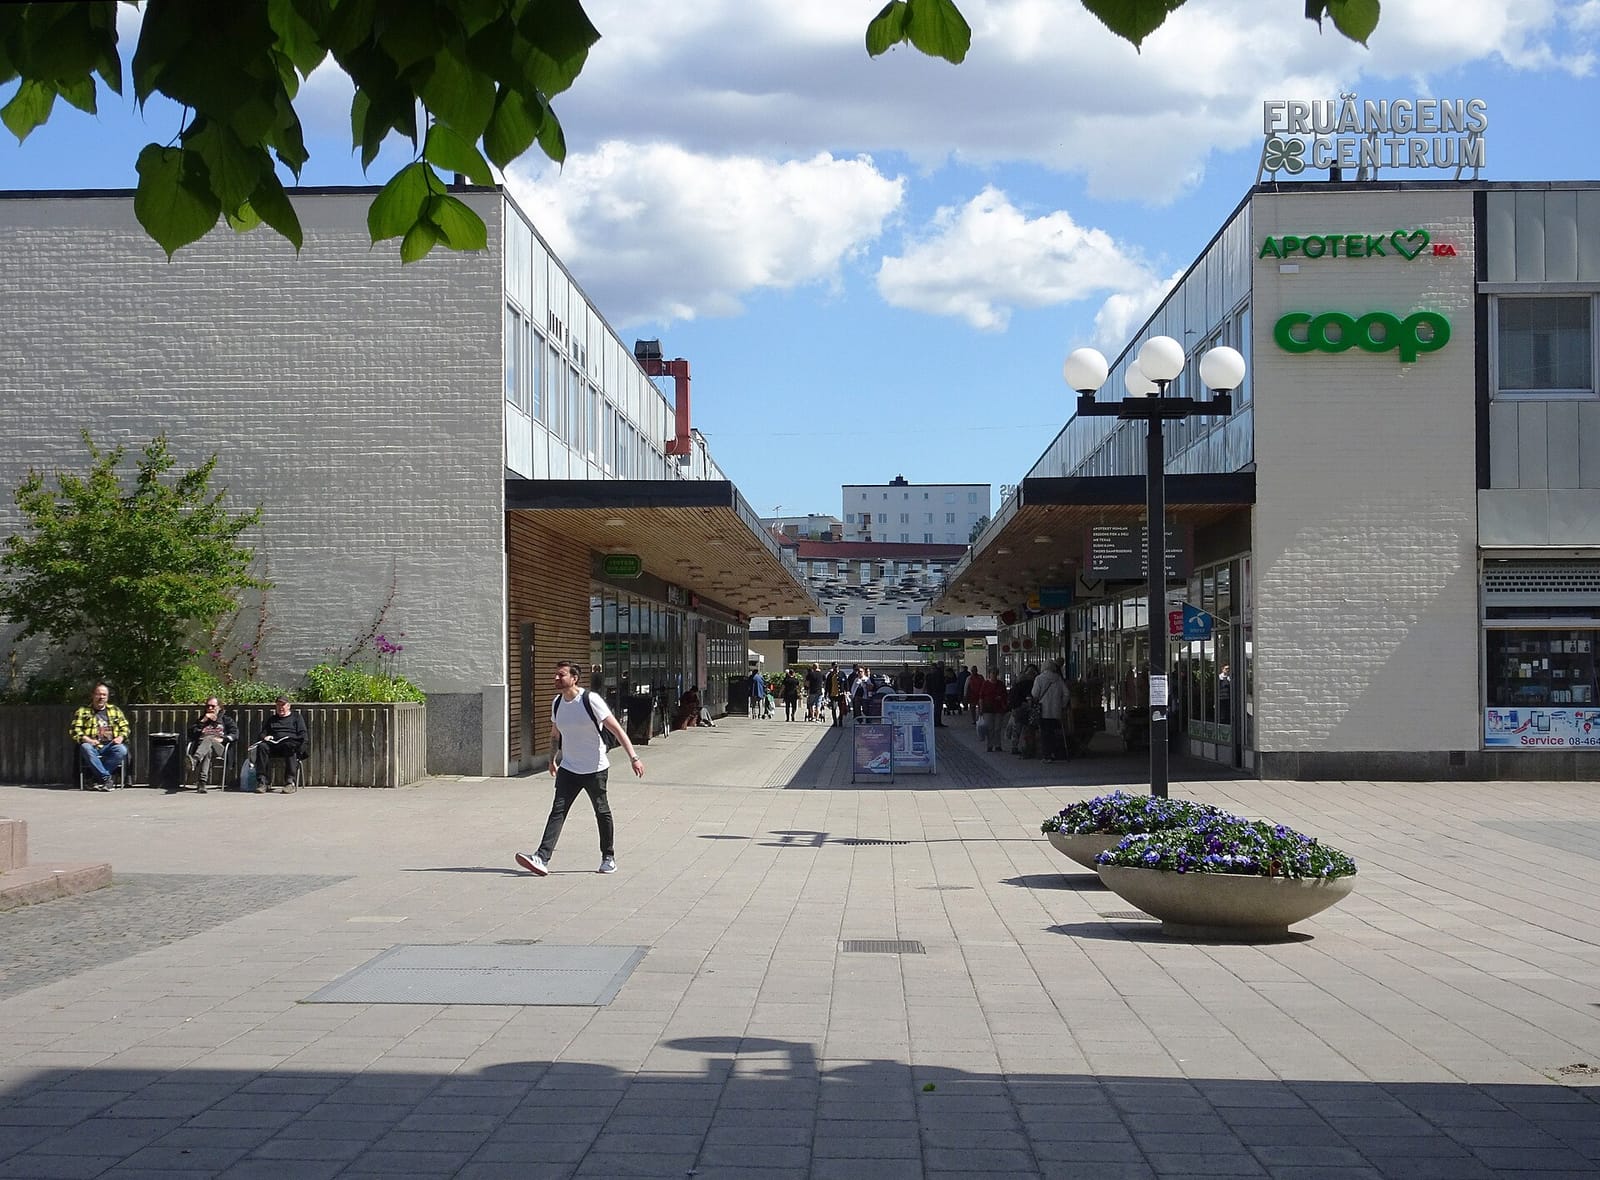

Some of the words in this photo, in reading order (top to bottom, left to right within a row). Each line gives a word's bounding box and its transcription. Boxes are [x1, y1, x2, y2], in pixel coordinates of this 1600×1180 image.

[1263, 91, 1488, 134] FRUÄNGENS
[1312, 137, 1486, 169] CENTRUM
[1258, 234, 1386, 260] APOTEK
[1432, 244, 1457, 257] ICA
[1274, 311, 1452, 363] coop
[1521, 735, 1564, 745] Service
